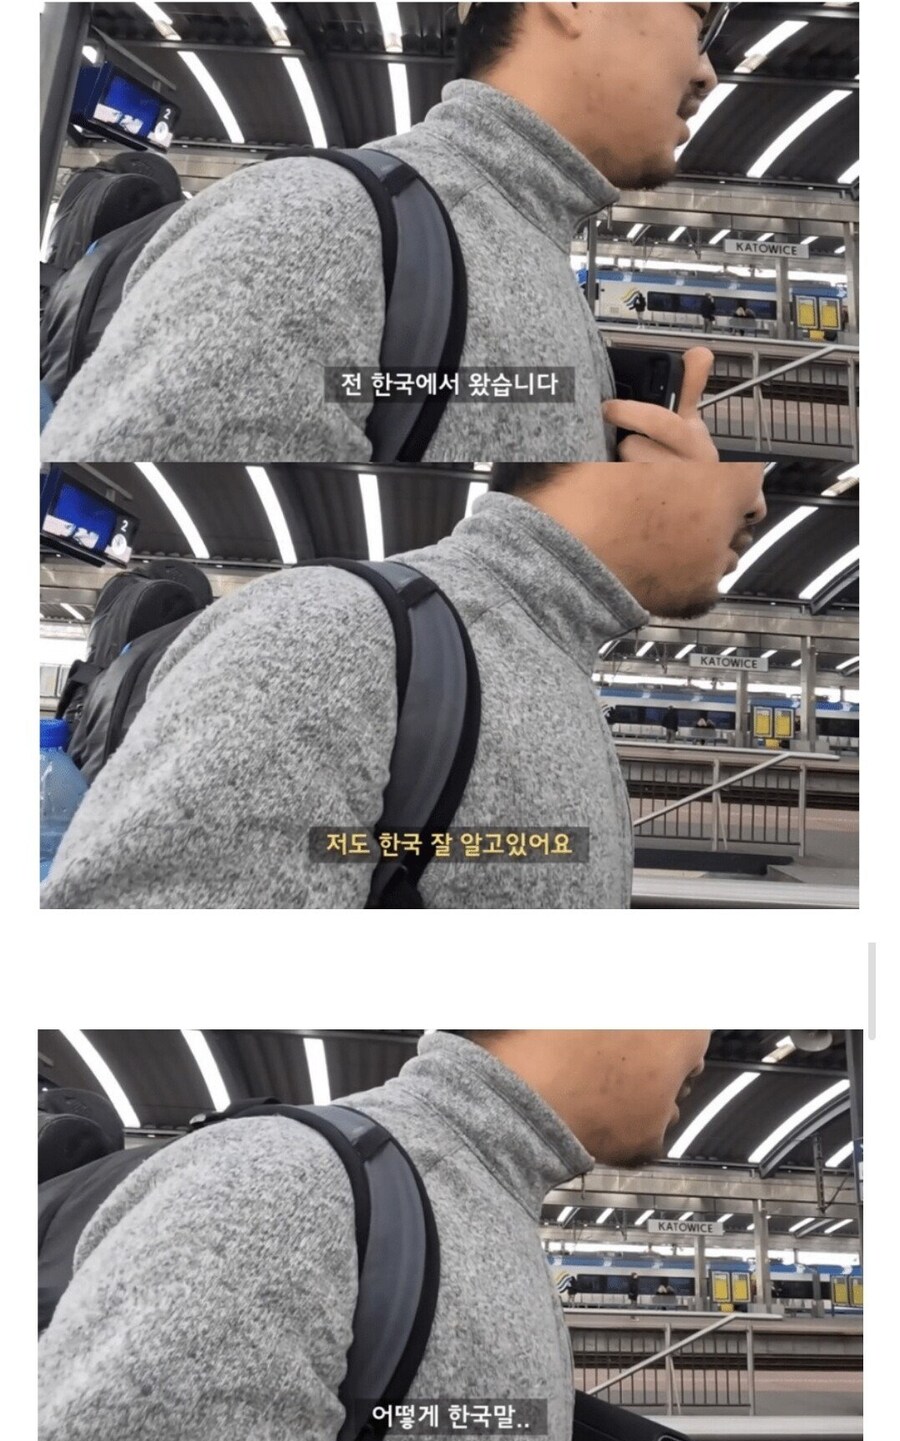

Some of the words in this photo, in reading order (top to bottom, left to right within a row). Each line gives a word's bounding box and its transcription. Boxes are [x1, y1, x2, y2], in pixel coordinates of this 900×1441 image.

[163, 107, 172, 120] 2
[735, 241, 798, 256] KATOWICE
[120, 519, 129, 533] 2
[700, 656, 758, 669] KATOWICE
[658, 1221, 713, 1233] KATOWICE
